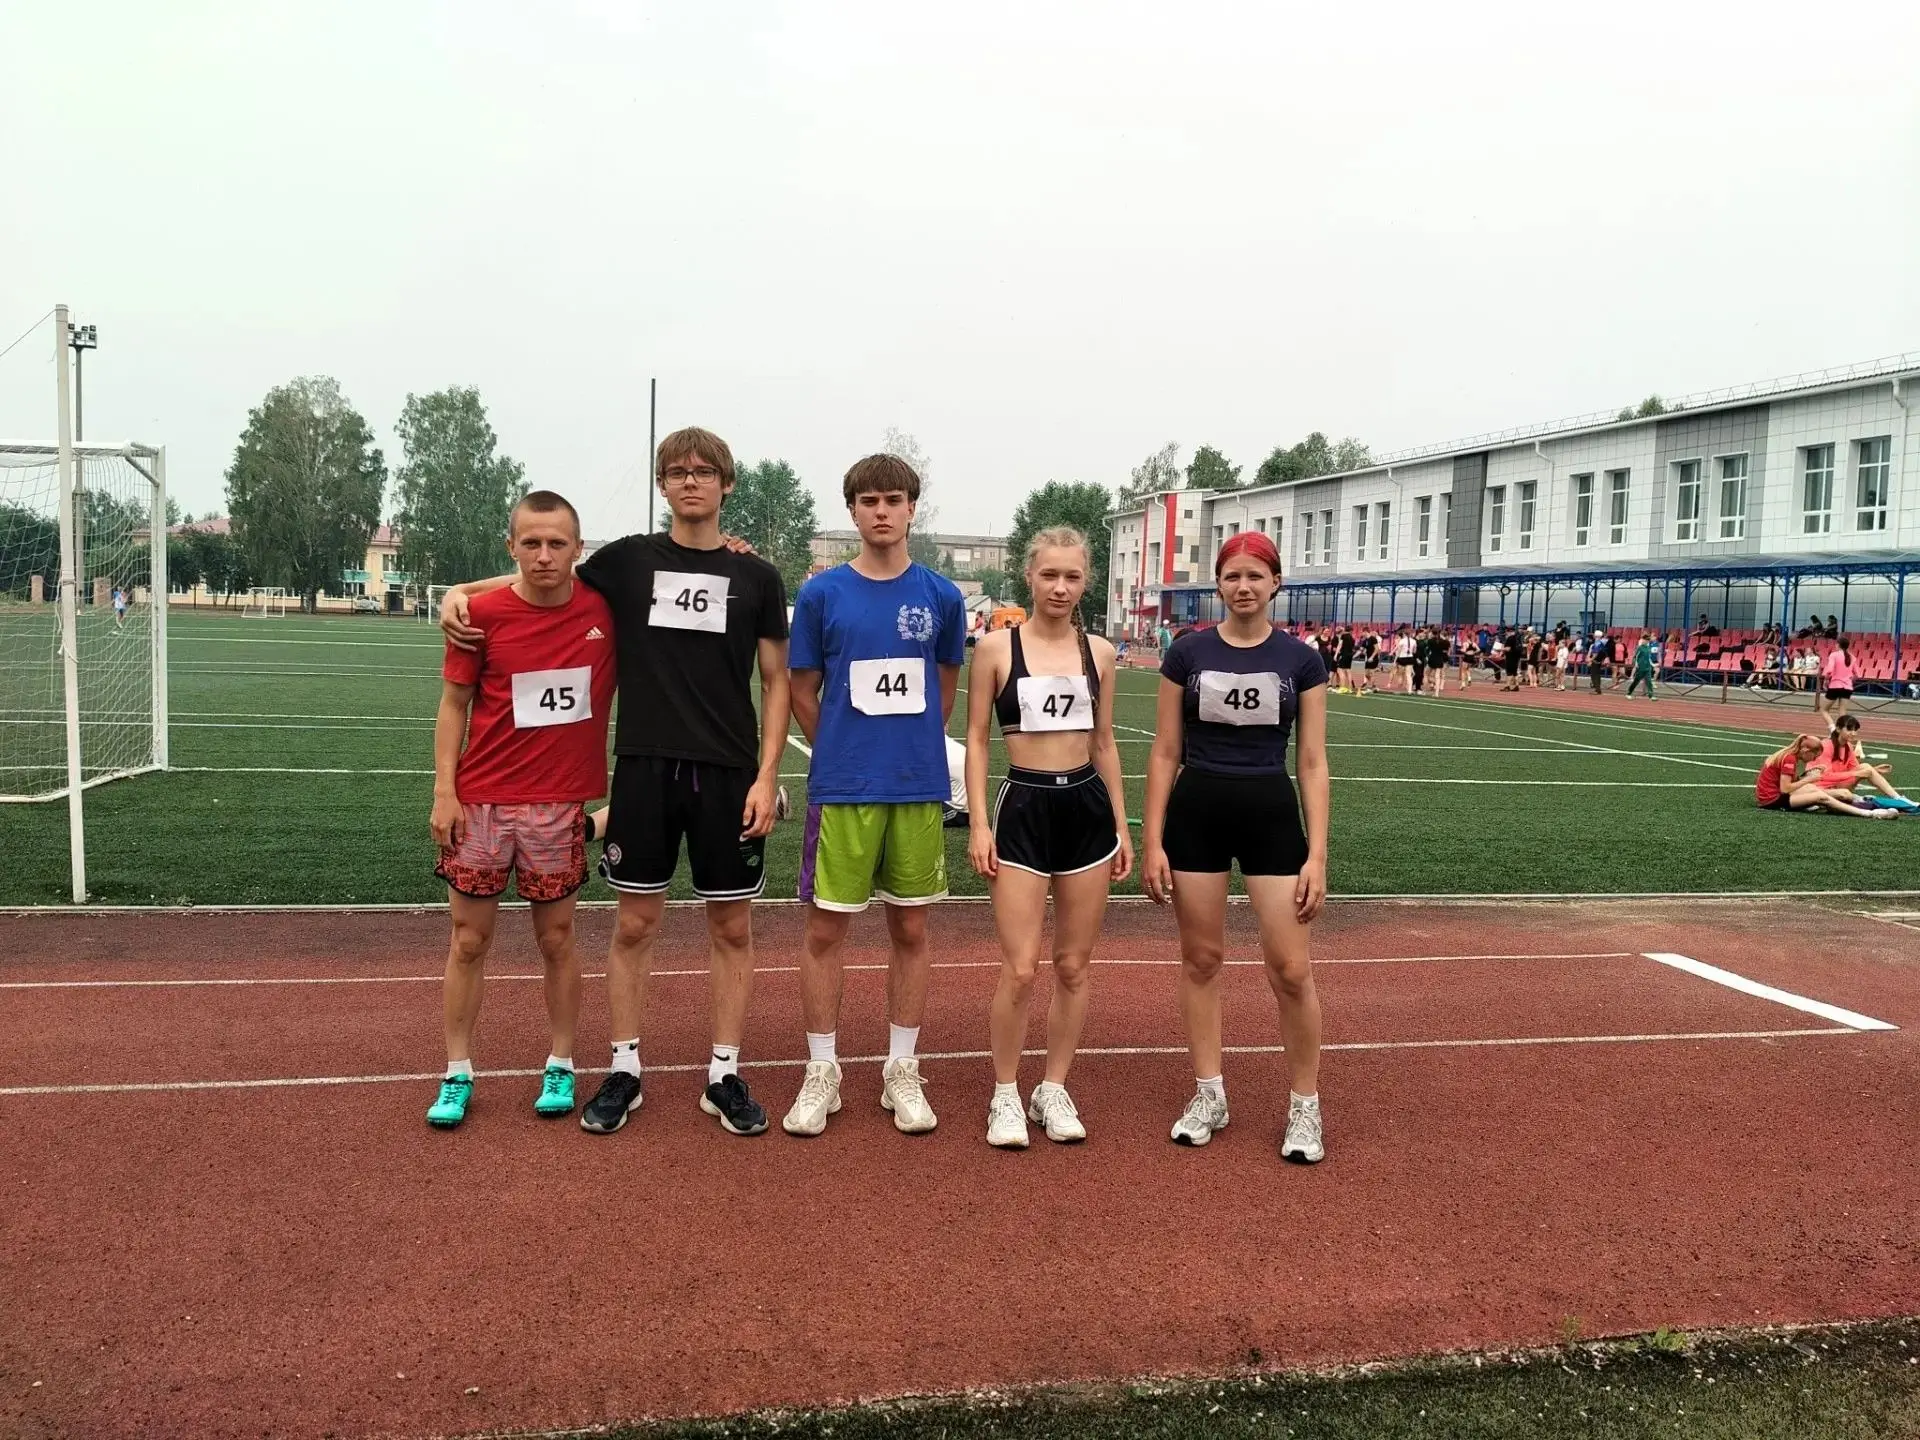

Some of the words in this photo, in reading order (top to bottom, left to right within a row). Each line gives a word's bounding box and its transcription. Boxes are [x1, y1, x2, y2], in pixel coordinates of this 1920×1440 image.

[675, 588, 708, 613] 46
[876, 673, 908, 697] 44
[540, 687, 576, 711] 45
[1042, 694, 1075, 718] 47
[1224, 687, 1260, 711] 48
